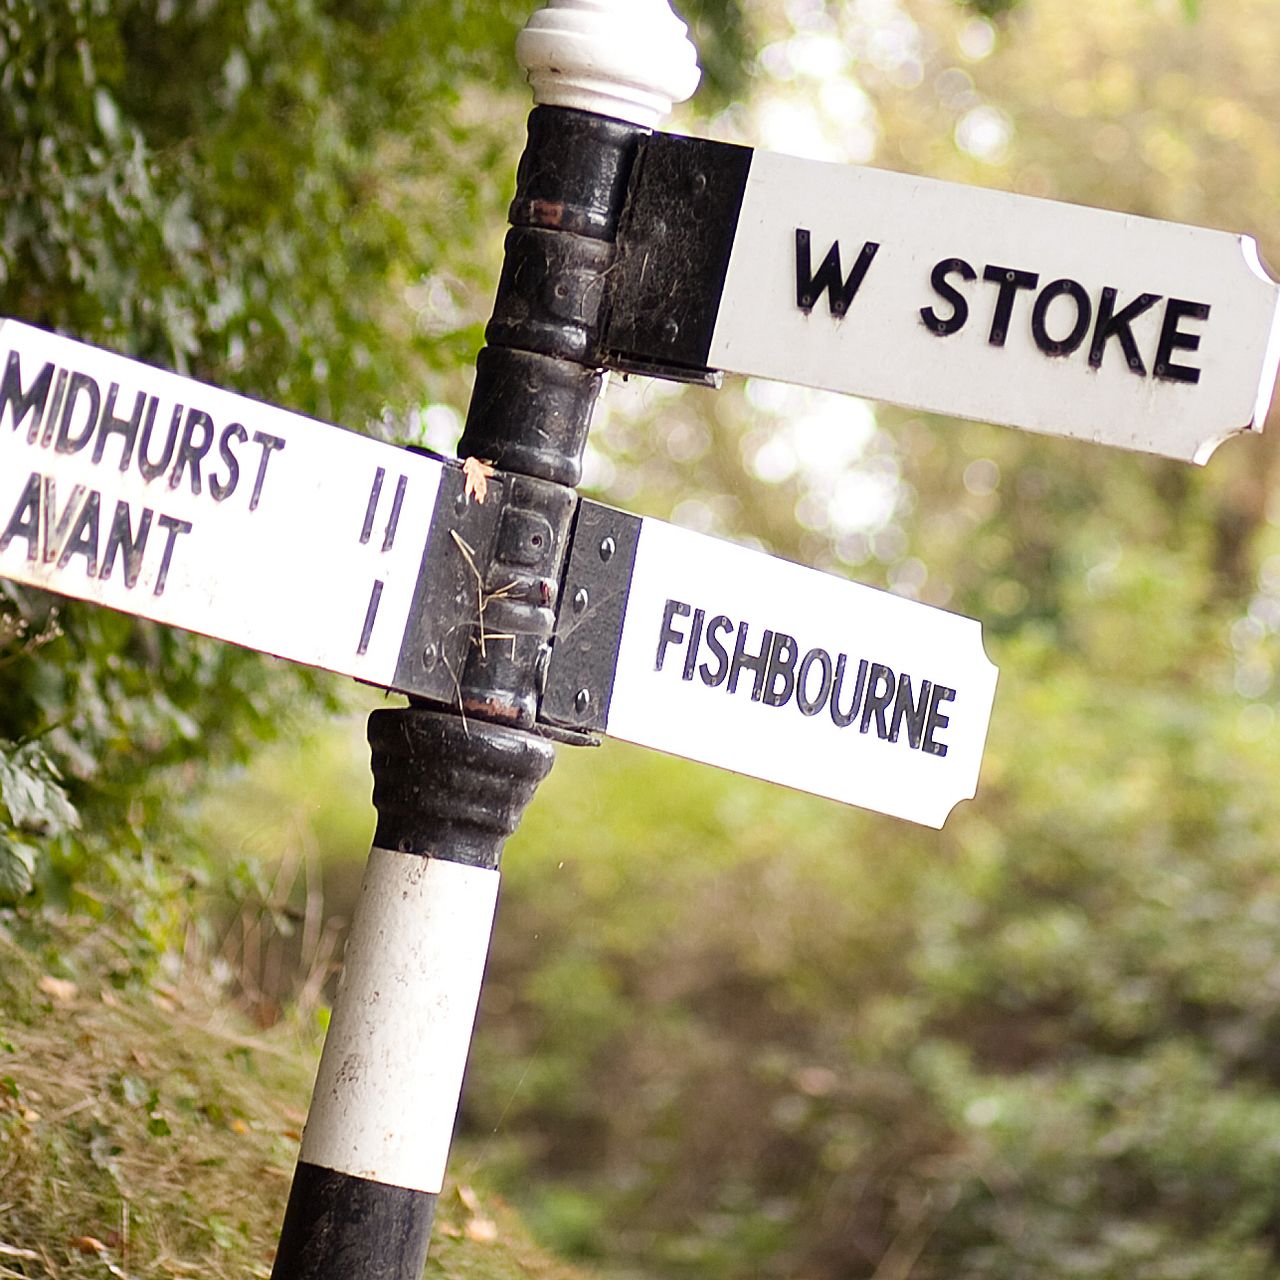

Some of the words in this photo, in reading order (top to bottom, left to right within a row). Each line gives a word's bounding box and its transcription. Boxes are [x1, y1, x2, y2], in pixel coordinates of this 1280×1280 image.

[795, 228, 880, 318] W
[919, 257, 1211, 384] STOKE
[654, 599, 956, 757] FISHBOURNE
